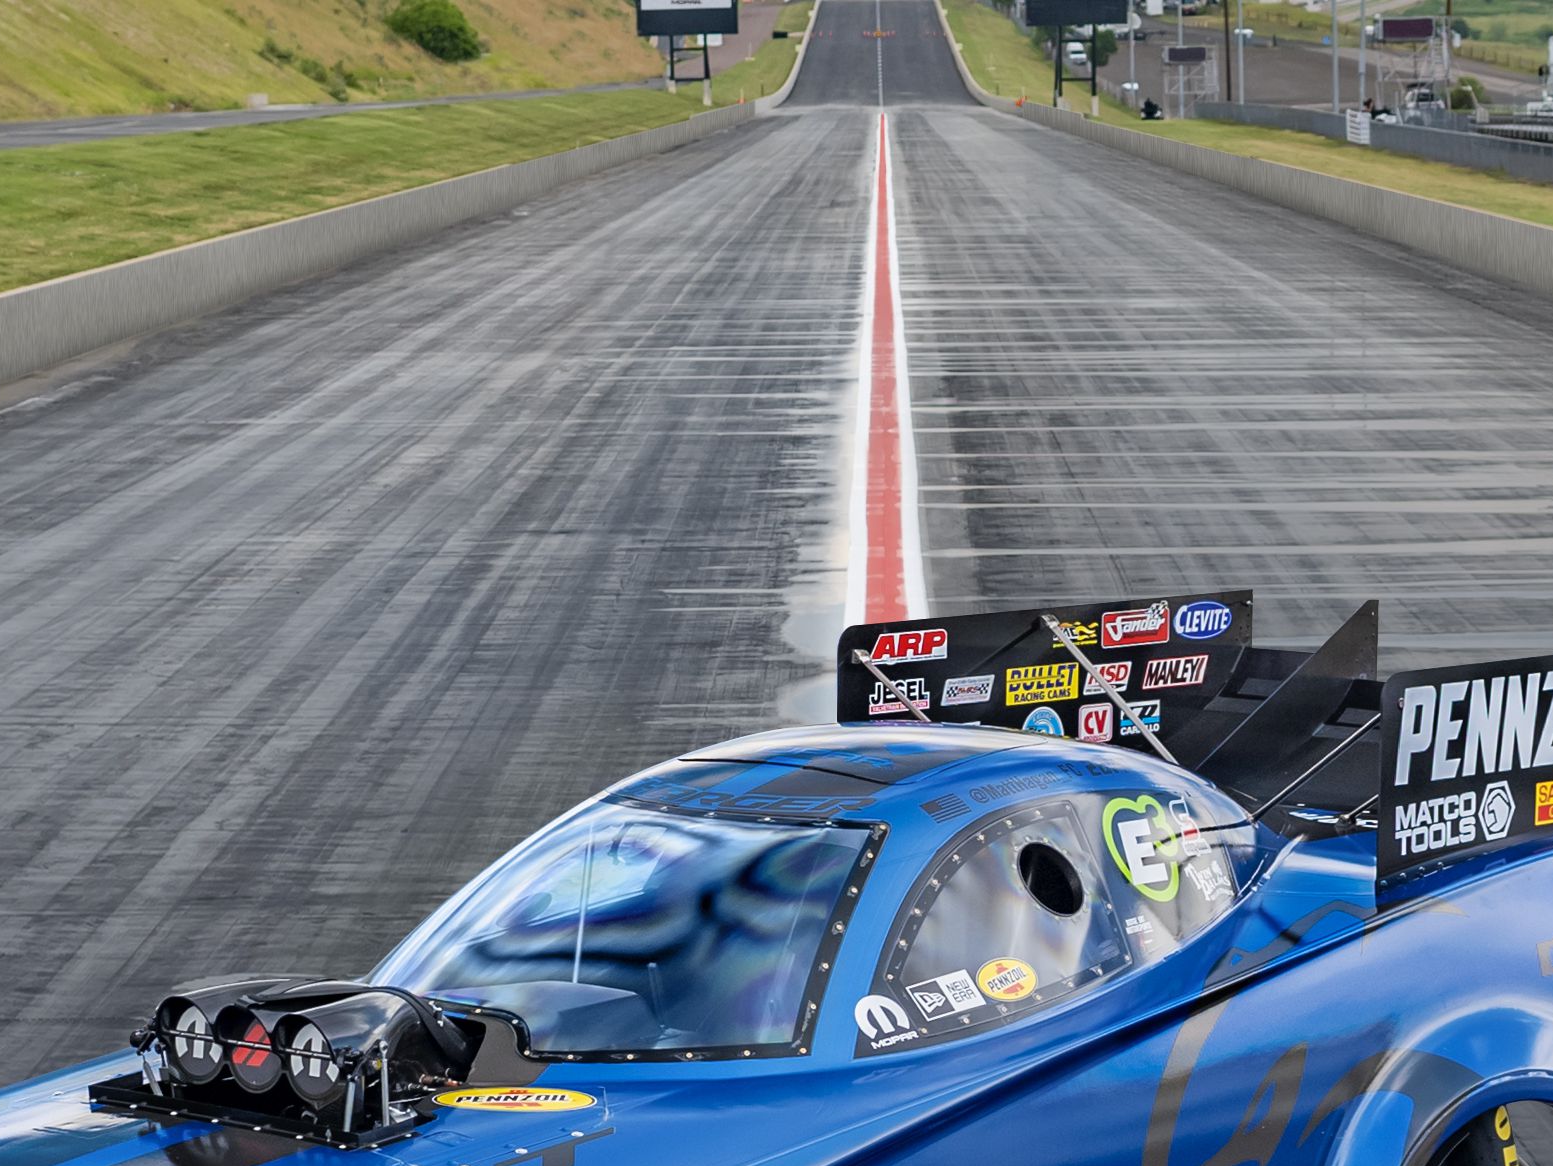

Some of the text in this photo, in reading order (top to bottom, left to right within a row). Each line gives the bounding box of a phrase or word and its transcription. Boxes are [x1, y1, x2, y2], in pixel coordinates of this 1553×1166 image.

[1174, 604, 1230, 634] CLEVITE
[871, 629, 947, 660] ARP
[1008, 663, 1077, 693] BULLET
[1087, 663, 1129, 685] MSD
[1145, 657, 1198, 687] MANLEY
[869, 678, 930, 706] JESEL
[1013, 690, 1046, 704] RACING
[1047, 688, 1072, 699] CAMS
[1083, 709, 1108, 735] CV
[1119, 722, 1162, 737] CARLO
[1394, 791, 1477, 832] MATCO
[1394, 815, 1477, 856] TOOLS
[945, 978, 970, 993] NEW
[986, 966, 1028, 993] PENNZOIL
[951, 988, 978, 1004] ERA
[870, 1030, 920, 1050] MOPAR
[454, 1093, 569, 1105] PENNZOIL
